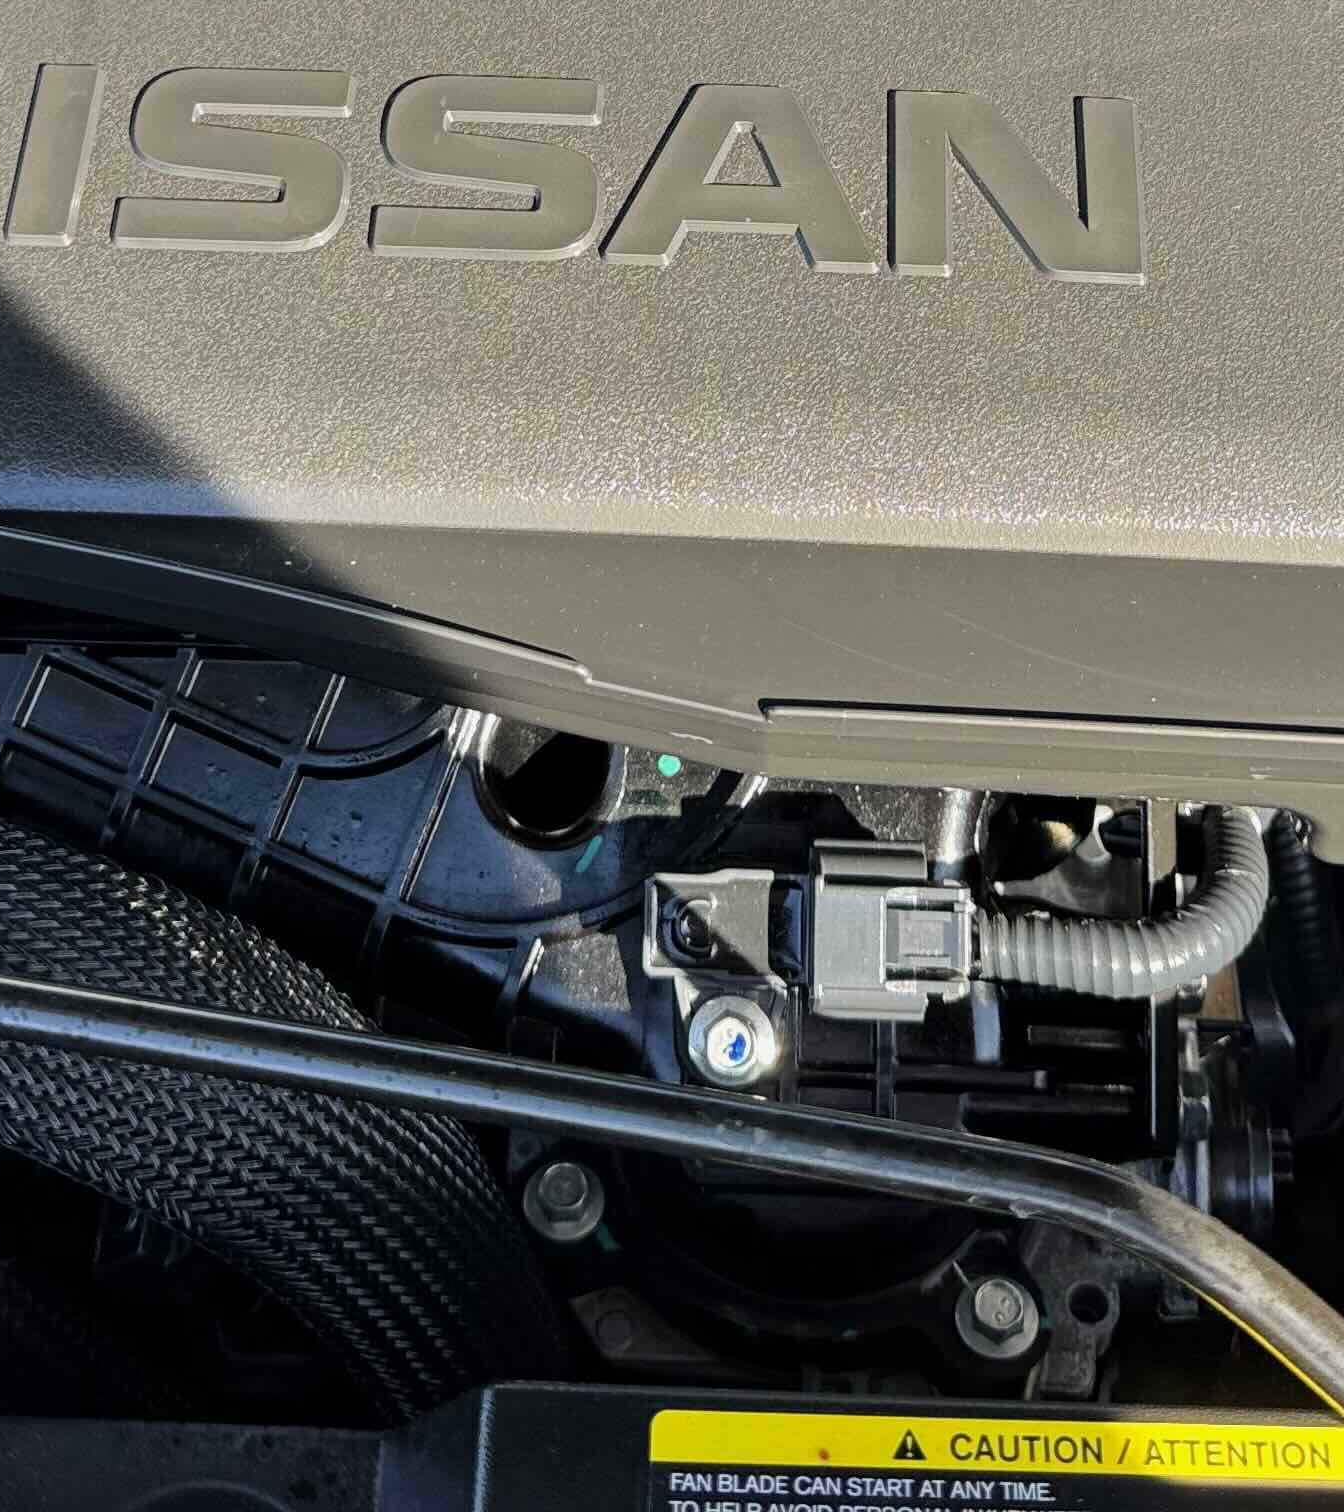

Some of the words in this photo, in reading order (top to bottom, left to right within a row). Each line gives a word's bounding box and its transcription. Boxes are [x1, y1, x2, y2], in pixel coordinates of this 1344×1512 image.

[949, 1433, 1104, 1464] CAUTION
[1144, 1439, 1332, 1469] ATTENTION
[670, 1472, 713, 1492] FAN
[717, 1473, 790, 1494] BLADE
[794, 1475, 842, 1496] CAN
[847, 1477, 915, 1497] START
[919, 1479, 946, 1498] AT
[949, 1480, 995, 1499] ANY
[999, 1481, 1056, 1501] TIME.
